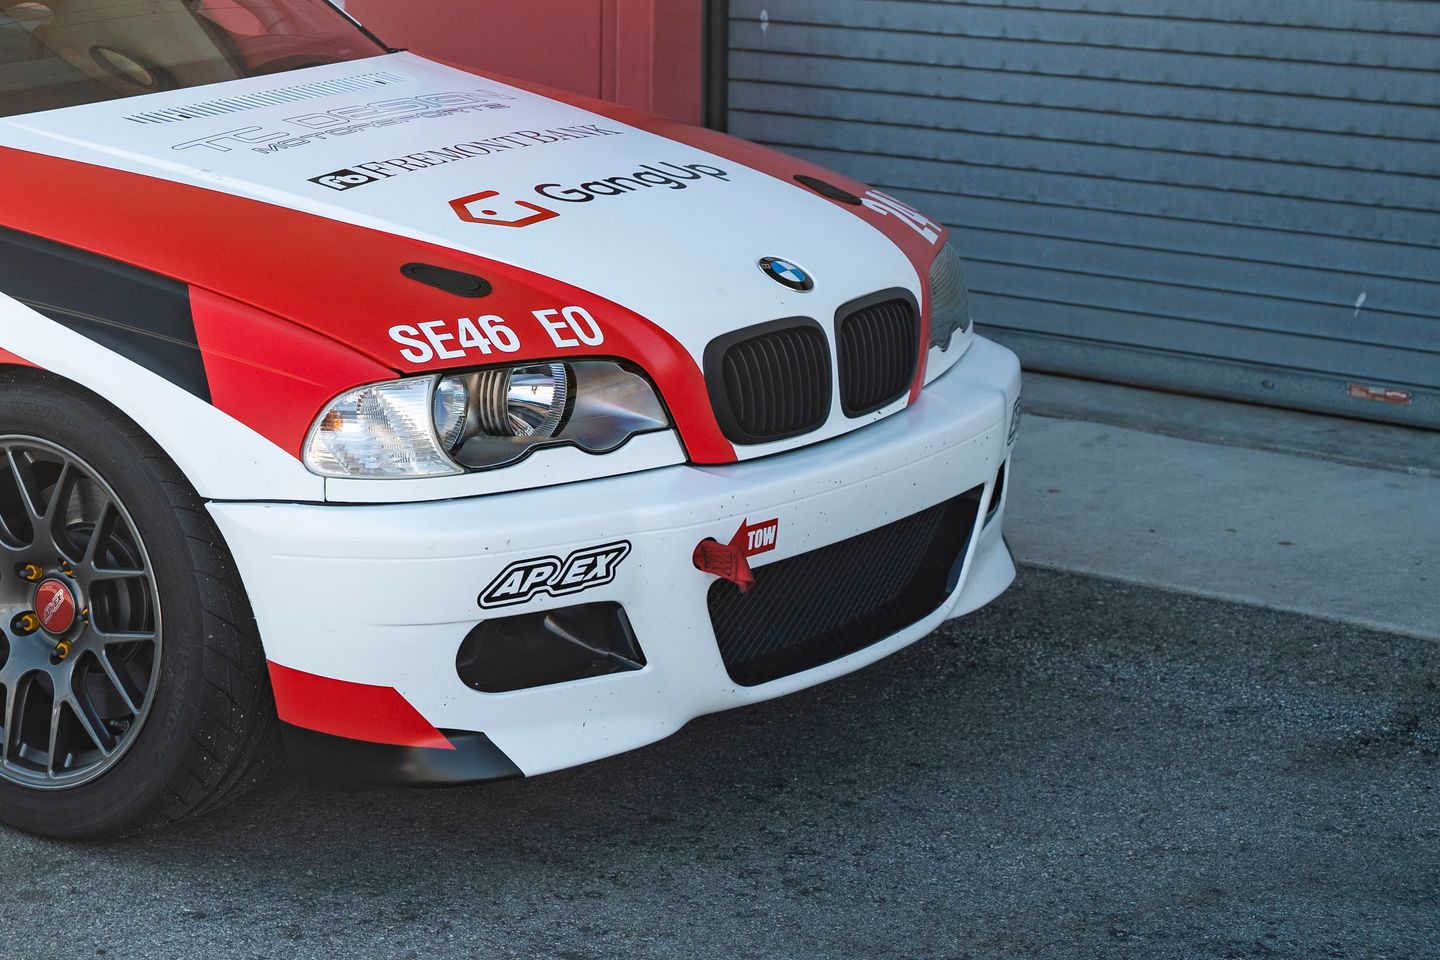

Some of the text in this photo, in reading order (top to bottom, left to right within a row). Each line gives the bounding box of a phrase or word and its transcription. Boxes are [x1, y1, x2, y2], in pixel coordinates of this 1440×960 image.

[282, 89, 517, 130] DESIGN
[534, 161, 731, 204] GangUp
[387, 313, 522, 364] SE46
[747, 524, 777, 551] TOW
[488, 550, 620, 598] APEX
